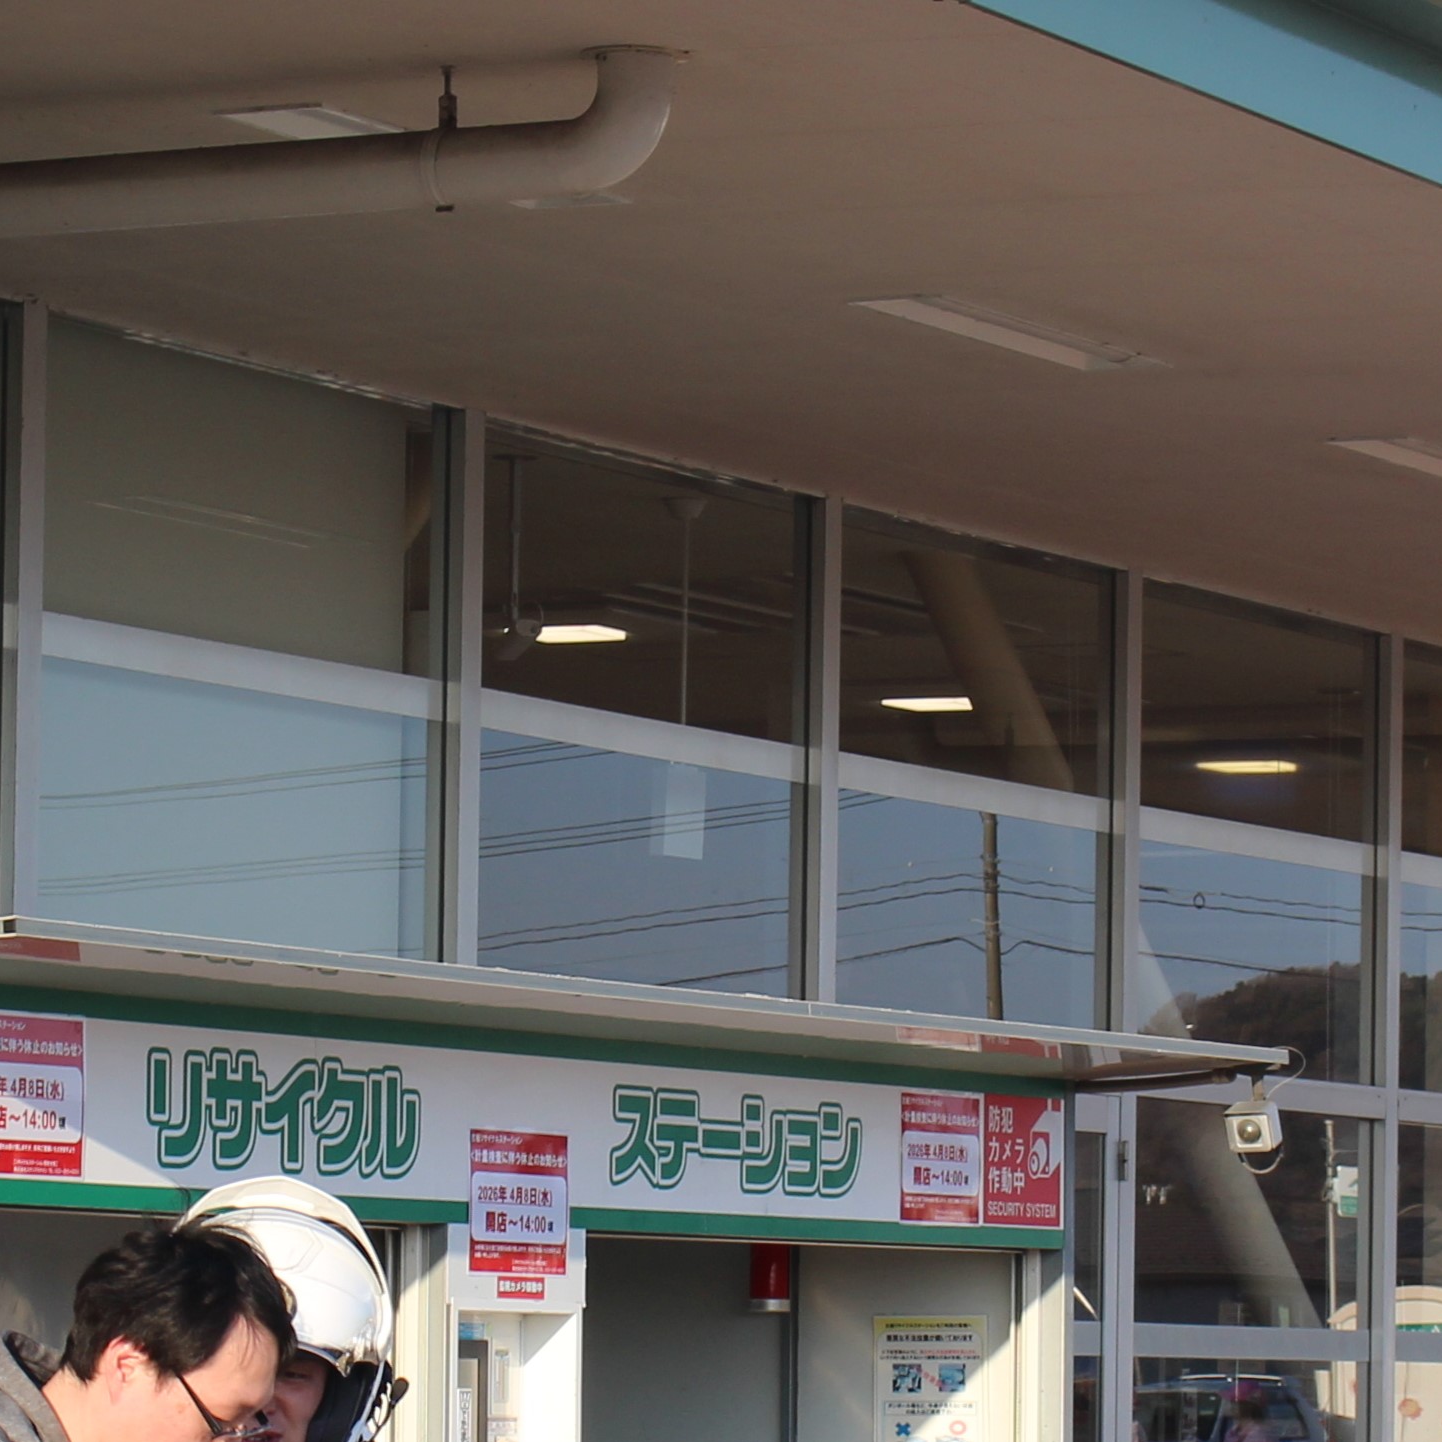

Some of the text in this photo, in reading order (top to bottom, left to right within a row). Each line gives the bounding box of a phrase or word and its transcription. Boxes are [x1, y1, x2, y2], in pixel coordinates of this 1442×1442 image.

[10, 1078, 64, 1101] 4月8日(水)
[147, 1046, 862, 1198] リサイクル ステーション
[988, 1105, 1014, 1134] 防犯
[989, 1136, 1025, 1164] カメラ
[988, 1166, 1025, 1195] 作動中
[478, 1185, 552, 1207] 2026年 4月8日(水)
[988, 1201, 1024, 1217] SECURITY
[1026, 1203, 1056, 1218] SYSTEM
